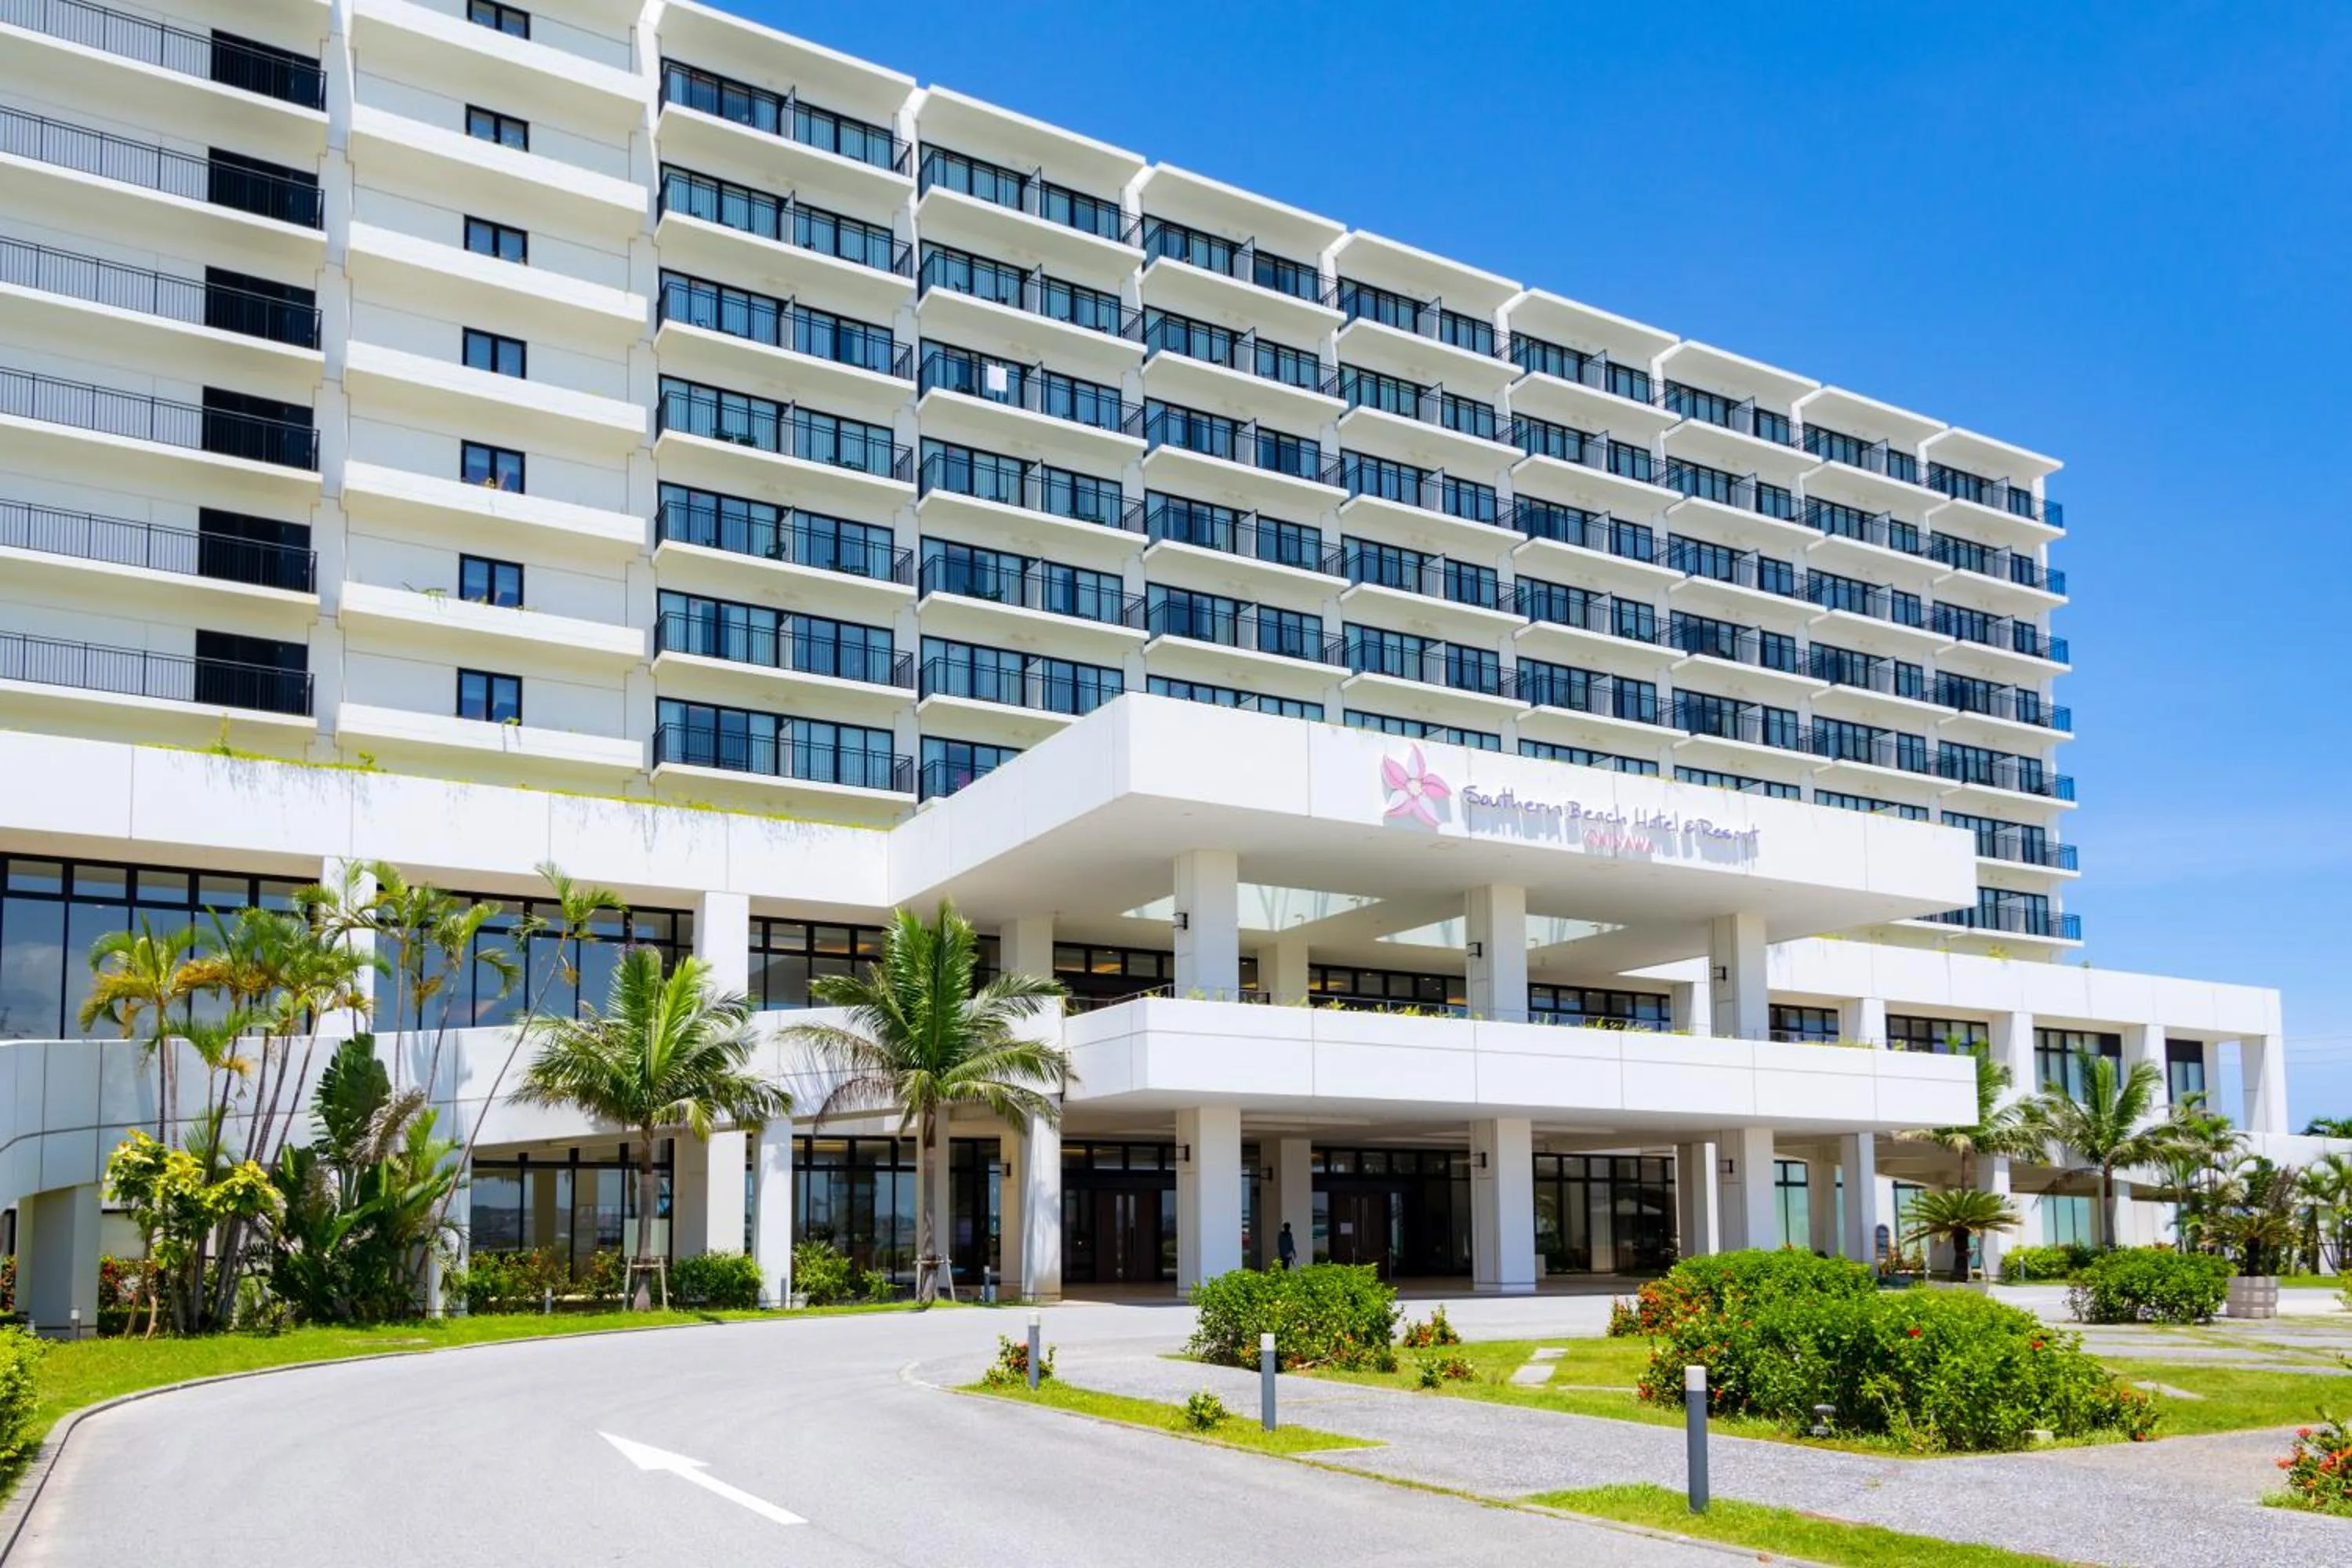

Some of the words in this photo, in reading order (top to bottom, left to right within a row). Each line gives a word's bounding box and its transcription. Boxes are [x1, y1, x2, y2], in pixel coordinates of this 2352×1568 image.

[1463, 785, 1563, 815] Southern
[1567, 800, 1628, 825] Beach
[1635, 806, 1679, 833] Hotel
[1696, 818, 1761, 841] Resort
